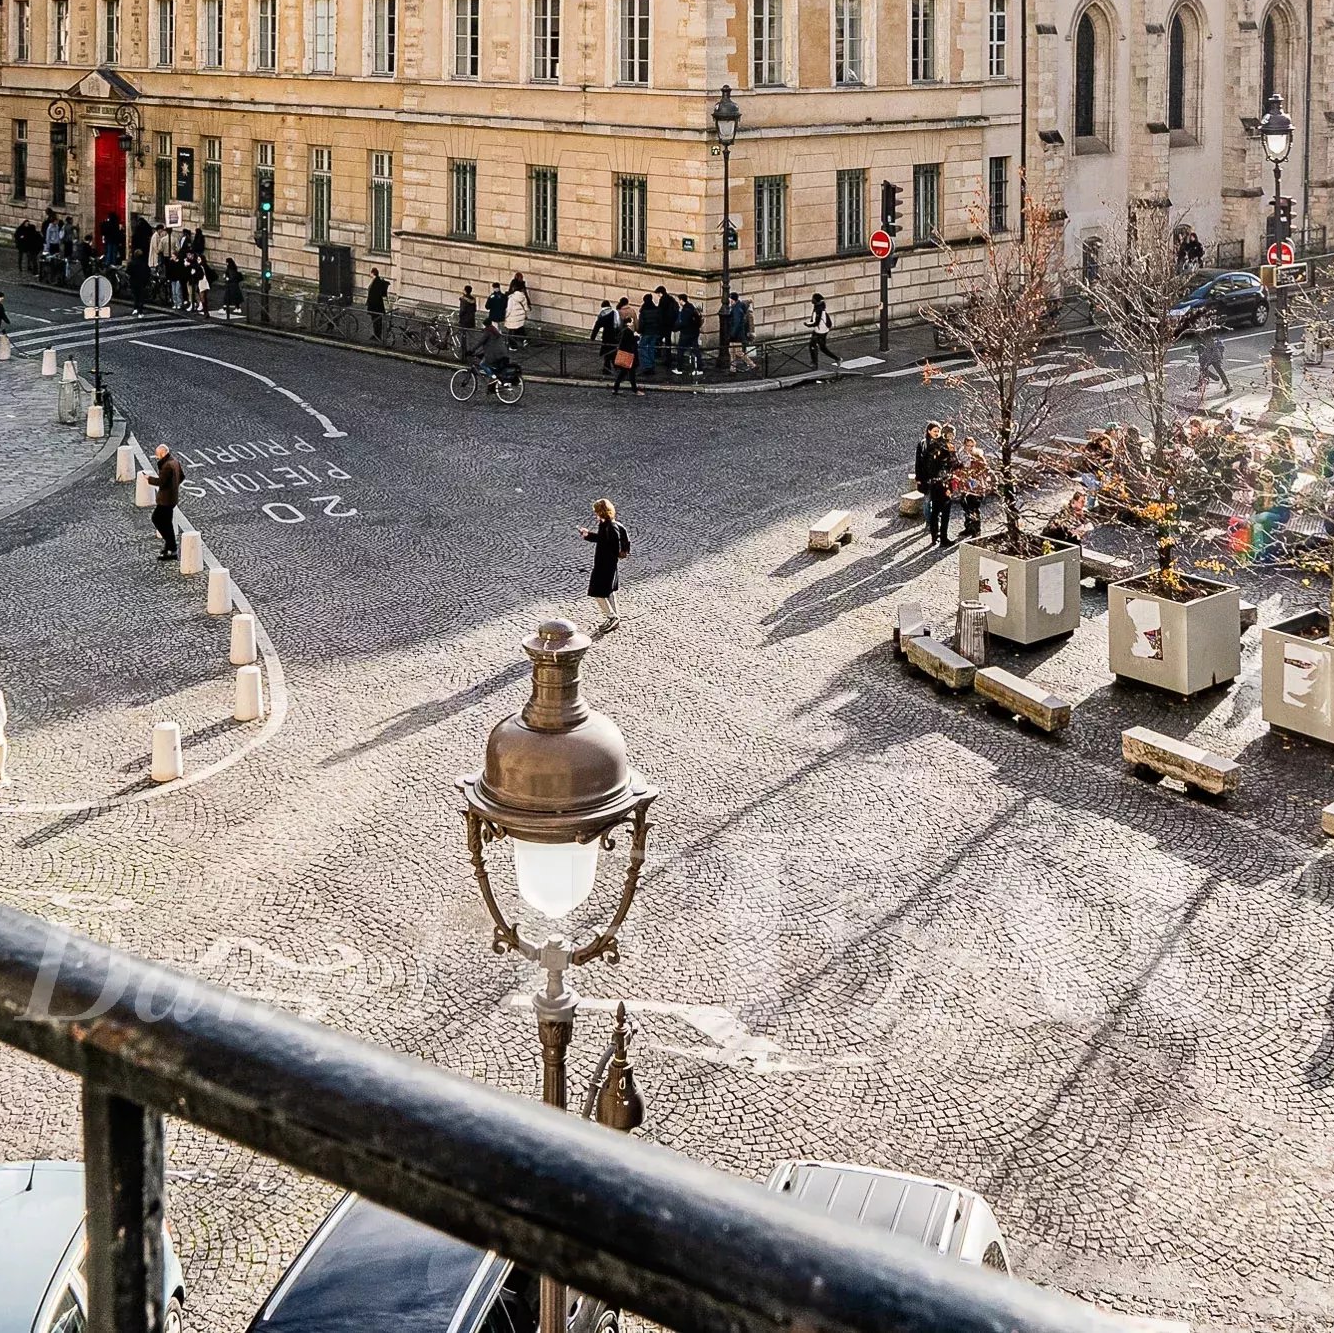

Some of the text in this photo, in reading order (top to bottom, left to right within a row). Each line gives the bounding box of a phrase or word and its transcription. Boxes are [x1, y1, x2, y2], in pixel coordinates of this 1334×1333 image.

[151, 435, 317, 468] PRIORIT
[180, 460, 352, 498] PIETONS
[262, 495, 358, 524] 20
